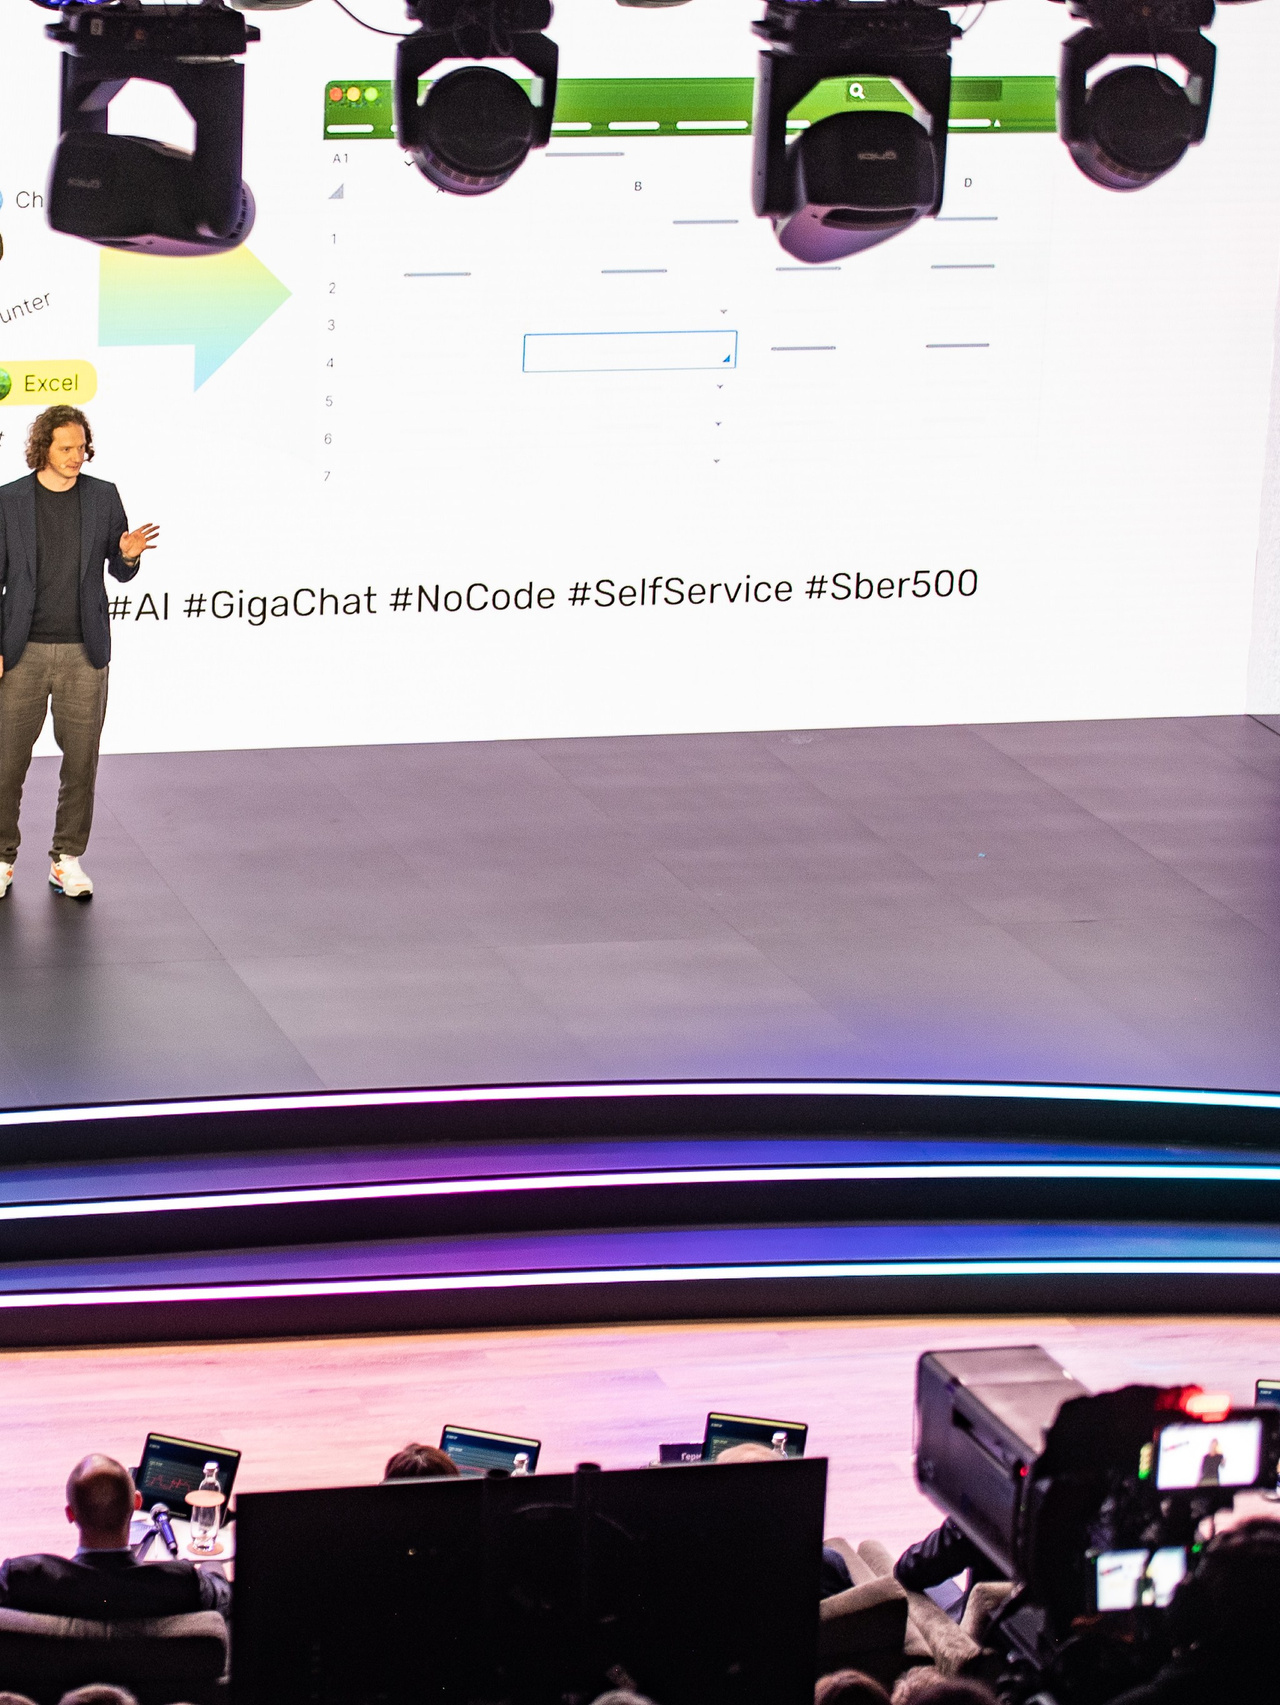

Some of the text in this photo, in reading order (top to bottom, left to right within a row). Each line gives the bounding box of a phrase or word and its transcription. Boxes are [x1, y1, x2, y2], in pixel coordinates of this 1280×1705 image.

[634, 180, 643, 192] B
[963, 177, 973, 188] D
[15, 190, 44, 209] Ch
[328, 281, 337, 294] 2
[327, 318, 337, 332] 3
[326, 357, 335, 368] 4
[25, 374, 78, 392] Excel
[325, 395, 335, 407] 5
[324, 432, 333, 445] 6
[324, 470, 332, 482] 7
[108, 568, 978, 627] #AI #GigaChat #NoCode #SelfService #Sber500
